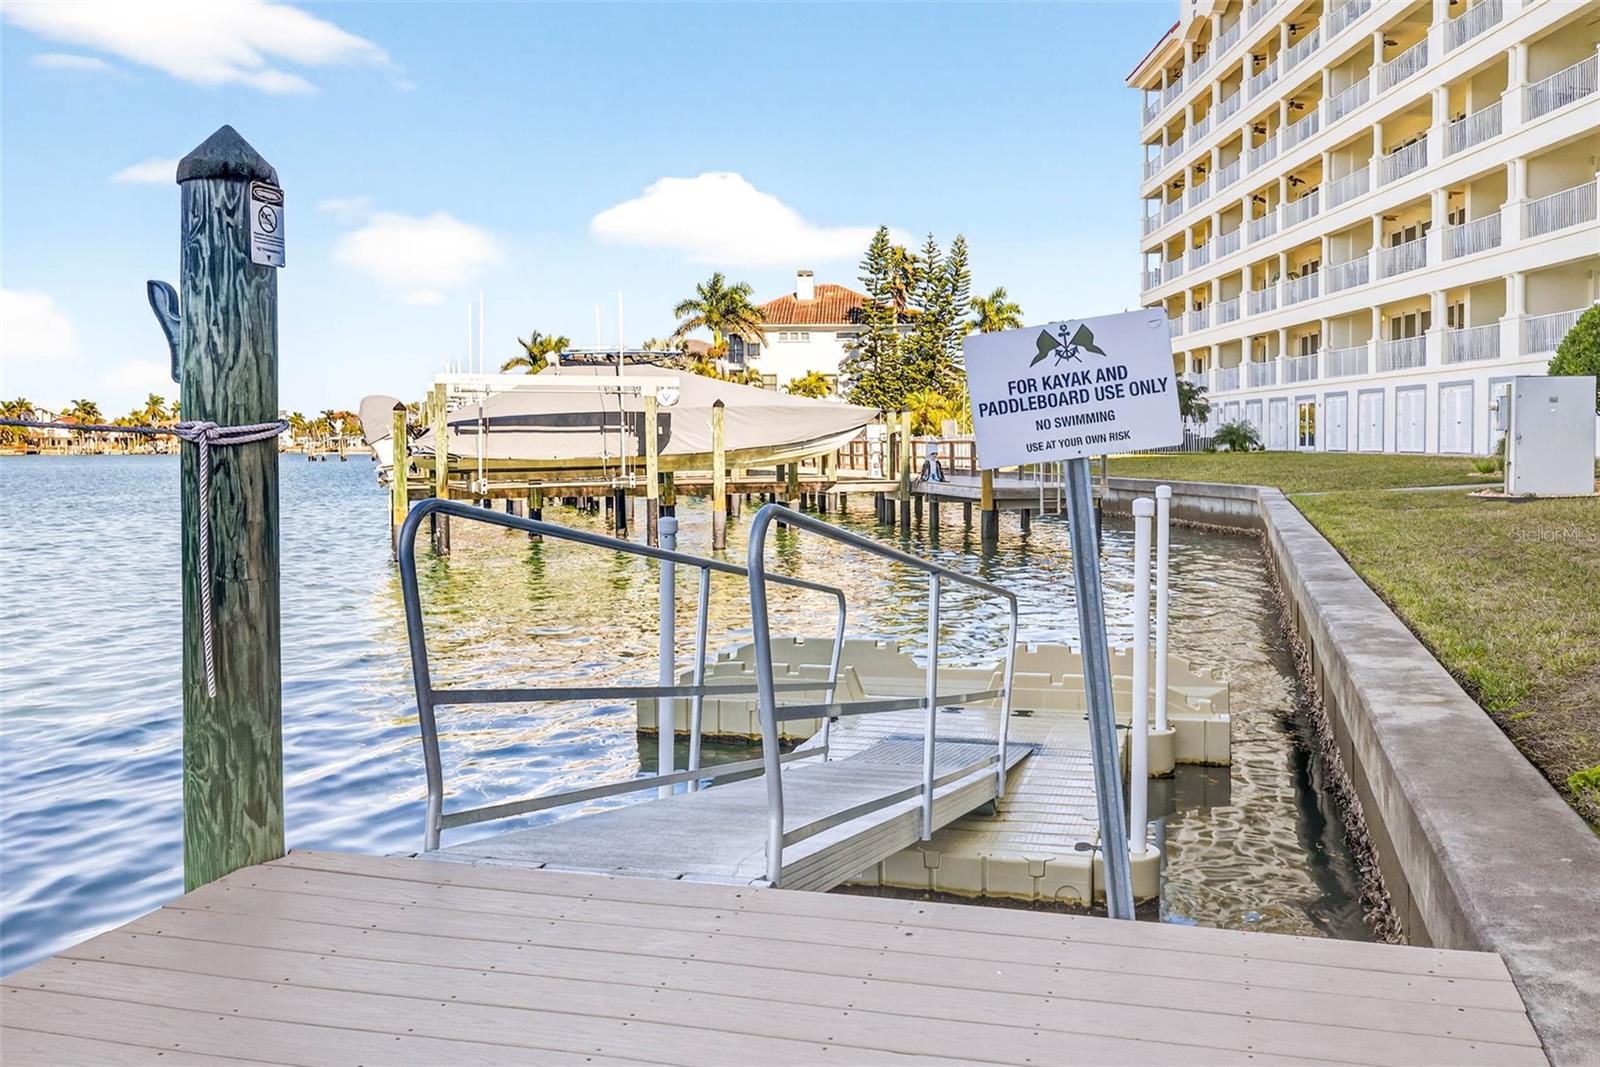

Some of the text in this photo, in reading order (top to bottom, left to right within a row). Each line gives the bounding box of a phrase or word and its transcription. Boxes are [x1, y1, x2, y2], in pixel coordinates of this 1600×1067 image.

[1008, 364, 1128, 396] FOR KAYAK AND
[979, 376, 1168, 418] PADDLEBOARD USE ONLY
[1035, 409, 1116, 431] NO SWIMMING
[1026, 430, 1131, 453] USE AT YOUR OWN RISK
